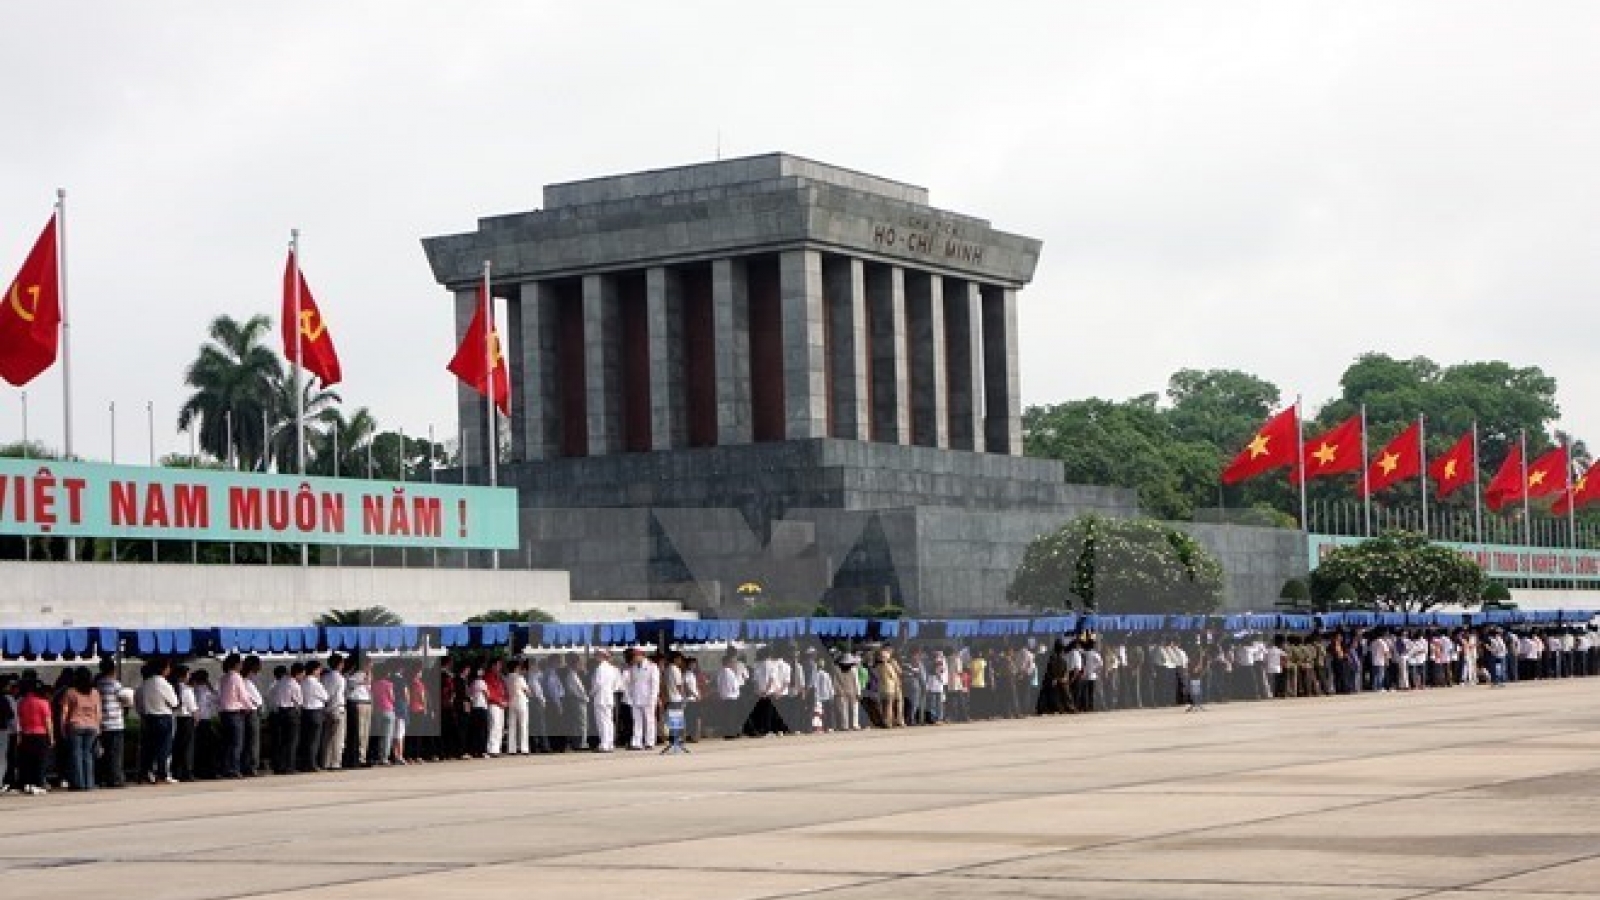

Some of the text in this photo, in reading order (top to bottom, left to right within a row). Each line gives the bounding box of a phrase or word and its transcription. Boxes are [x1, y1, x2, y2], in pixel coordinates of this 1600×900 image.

[945, 240, 983, 264] MINH
[109, 480, 209, 528] NAM
[229, 482, 345, 533] MUÔN
[362, 487, 442, 537] NĂM
[457, 499, 468, 537] !
